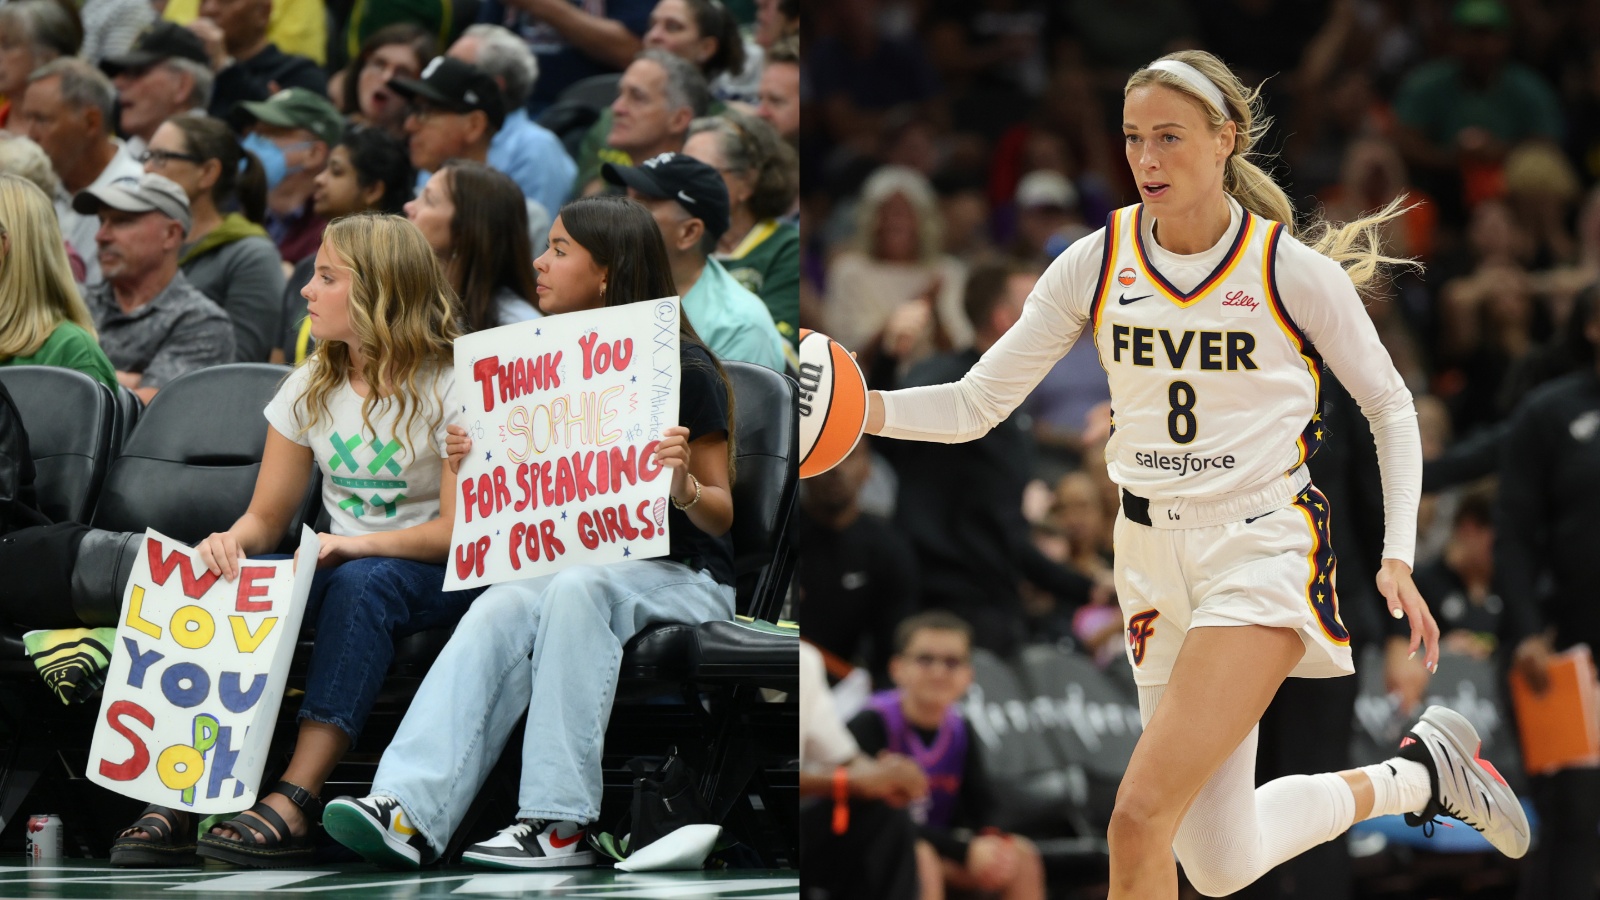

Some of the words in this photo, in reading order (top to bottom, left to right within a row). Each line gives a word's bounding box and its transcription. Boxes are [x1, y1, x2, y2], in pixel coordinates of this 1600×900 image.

[1221, 290, 1260, 312] Lilly
[473, 350, 563, 413] THANK
[578, 331, 634, 380] YOU
[1112, 323, 1260, 372] FEVER
[507, 384, 625, 464] SOPHIE
[625, 423, 643, 442] #8
[1167, 380, 1197, 445] 8
[333, 477, 404, 488] ATHLETICS
[461, 465, 512, 524] FOR
[513, 440, 665, 513] SPEAKING
[1135, 450, 1236, 477] salesforce
[455, 535, 491, 581] UP
[509, 518, 566, 571] FOR
[577, 496, 667, 551] GIRLS!
[147, 537, 277, 613] WE
[125, 583, 288, 654] LOV
[121, 635, 269, 714] YOU
